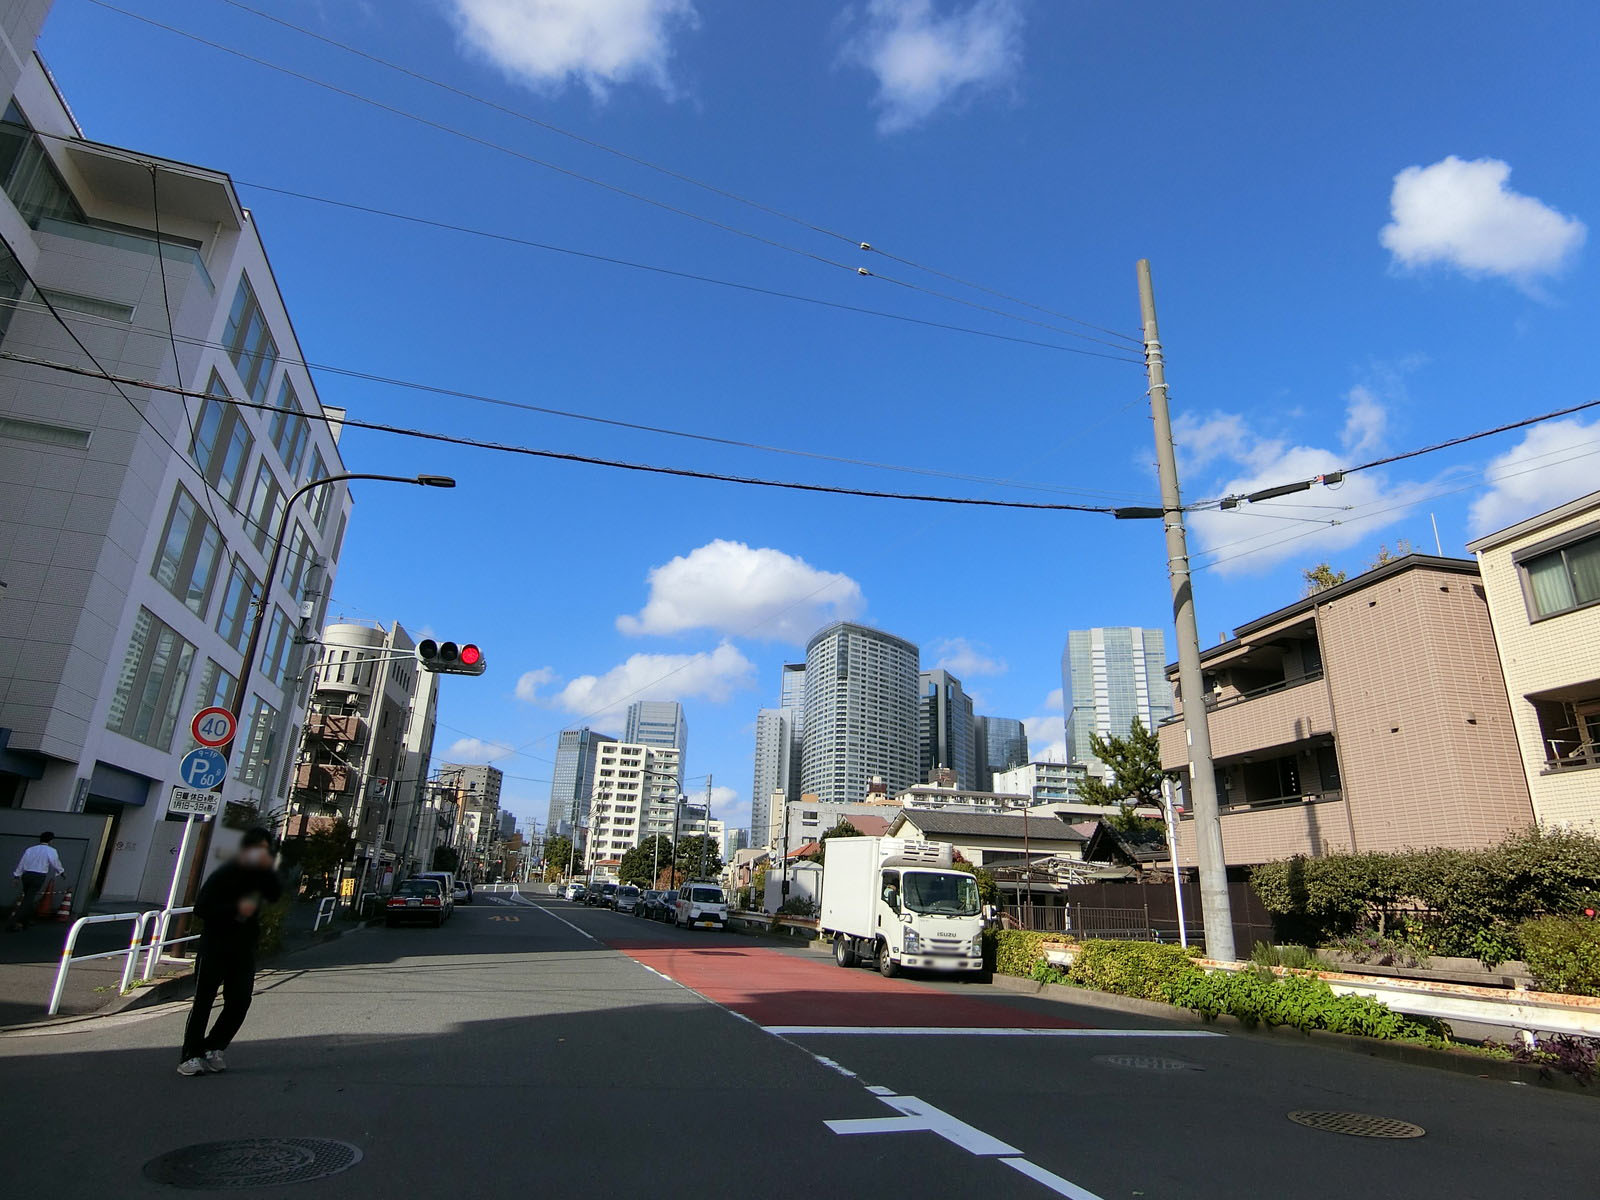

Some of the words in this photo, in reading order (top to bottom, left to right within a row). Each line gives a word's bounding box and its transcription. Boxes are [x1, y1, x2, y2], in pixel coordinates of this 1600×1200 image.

[202, 718, 227, 736] 40
[198, 750, 218, 758] 9-19
[188, 758, 210, 784] P
